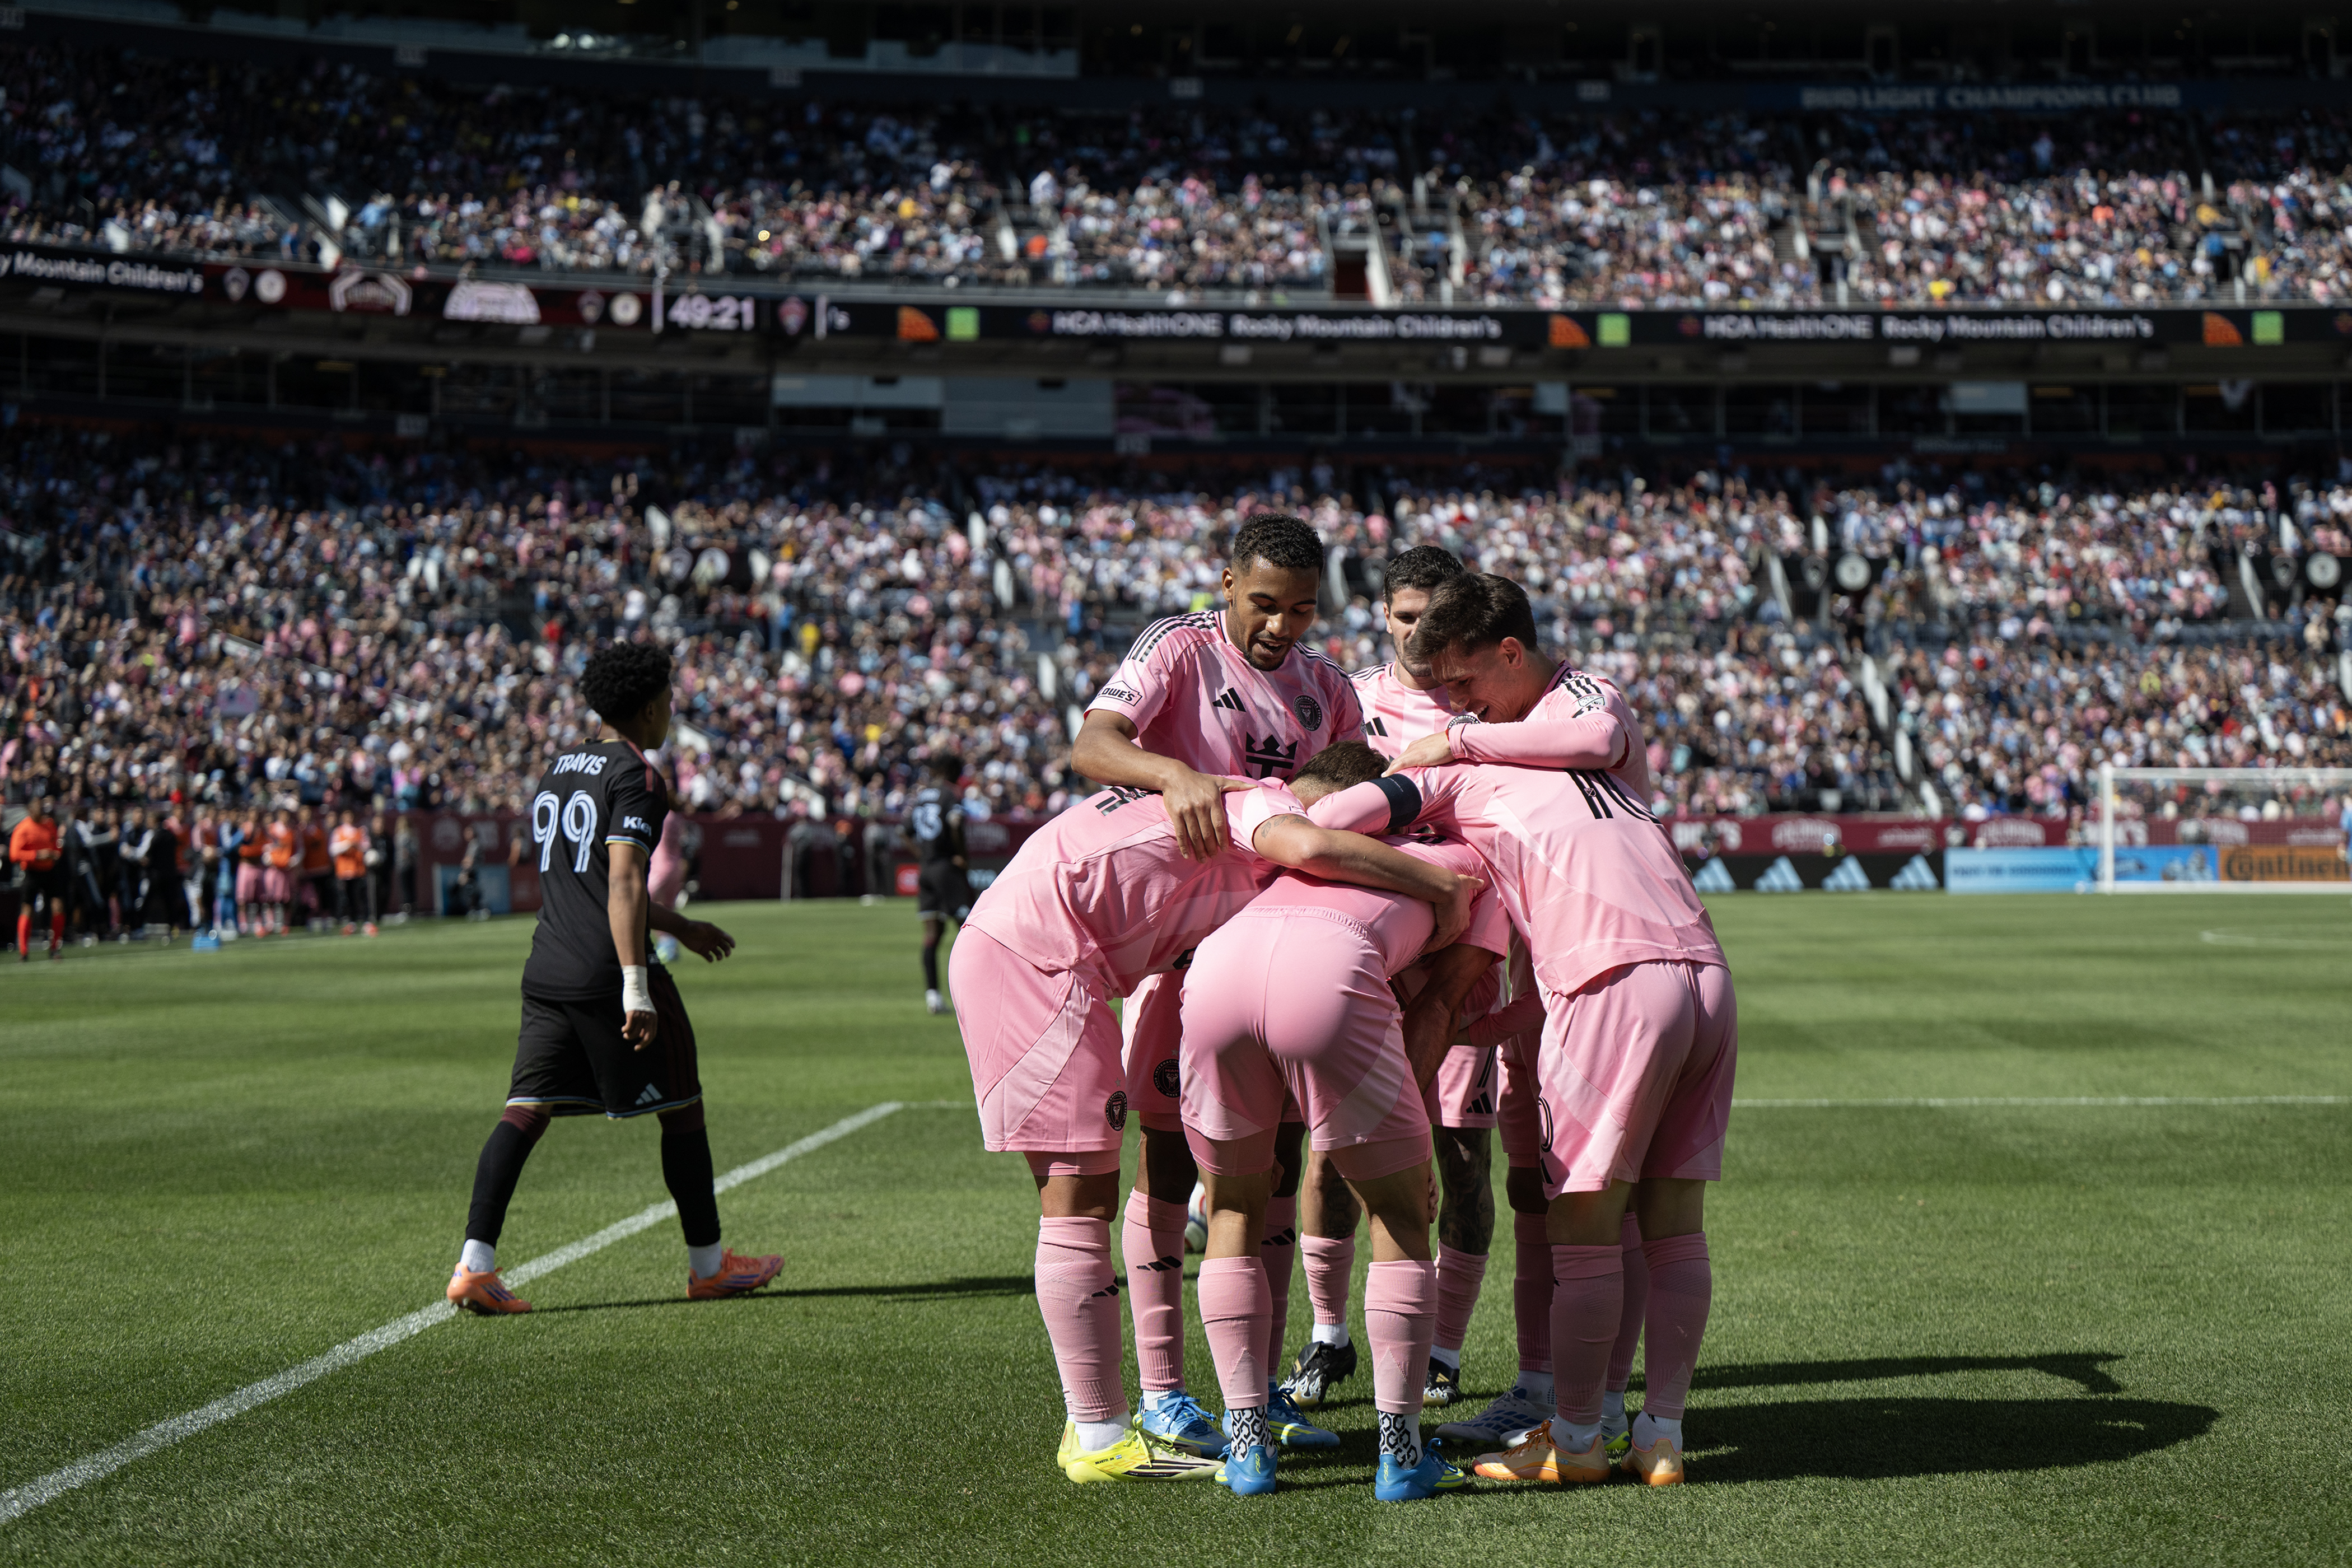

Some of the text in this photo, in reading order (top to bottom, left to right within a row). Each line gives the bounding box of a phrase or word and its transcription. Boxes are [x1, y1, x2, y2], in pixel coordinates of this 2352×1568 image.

[1860, 86, 1938, 109] LIGHT
[1945, 85, 2108, 108] CHAMPIONS
[2111, 83, 2180, 107] CLUB
[13, 251, 105, 283] Mountain
[107, 260, 204, 293] Children's
[668, 293, 755, 331] 49:21
[1053, 311, 1502, 341] HCA HealthONE Rocky Mountain Children's
[1704, 314, 2154, 343] HCA HealthONE Rocky Mountain Children's
[1098, 687, 1135, 702] OWE'S
[553, 753, 607, 776] TRAVIS
[533, 790, 598, 873] 99
[623, 816, 652, 837] Kie
